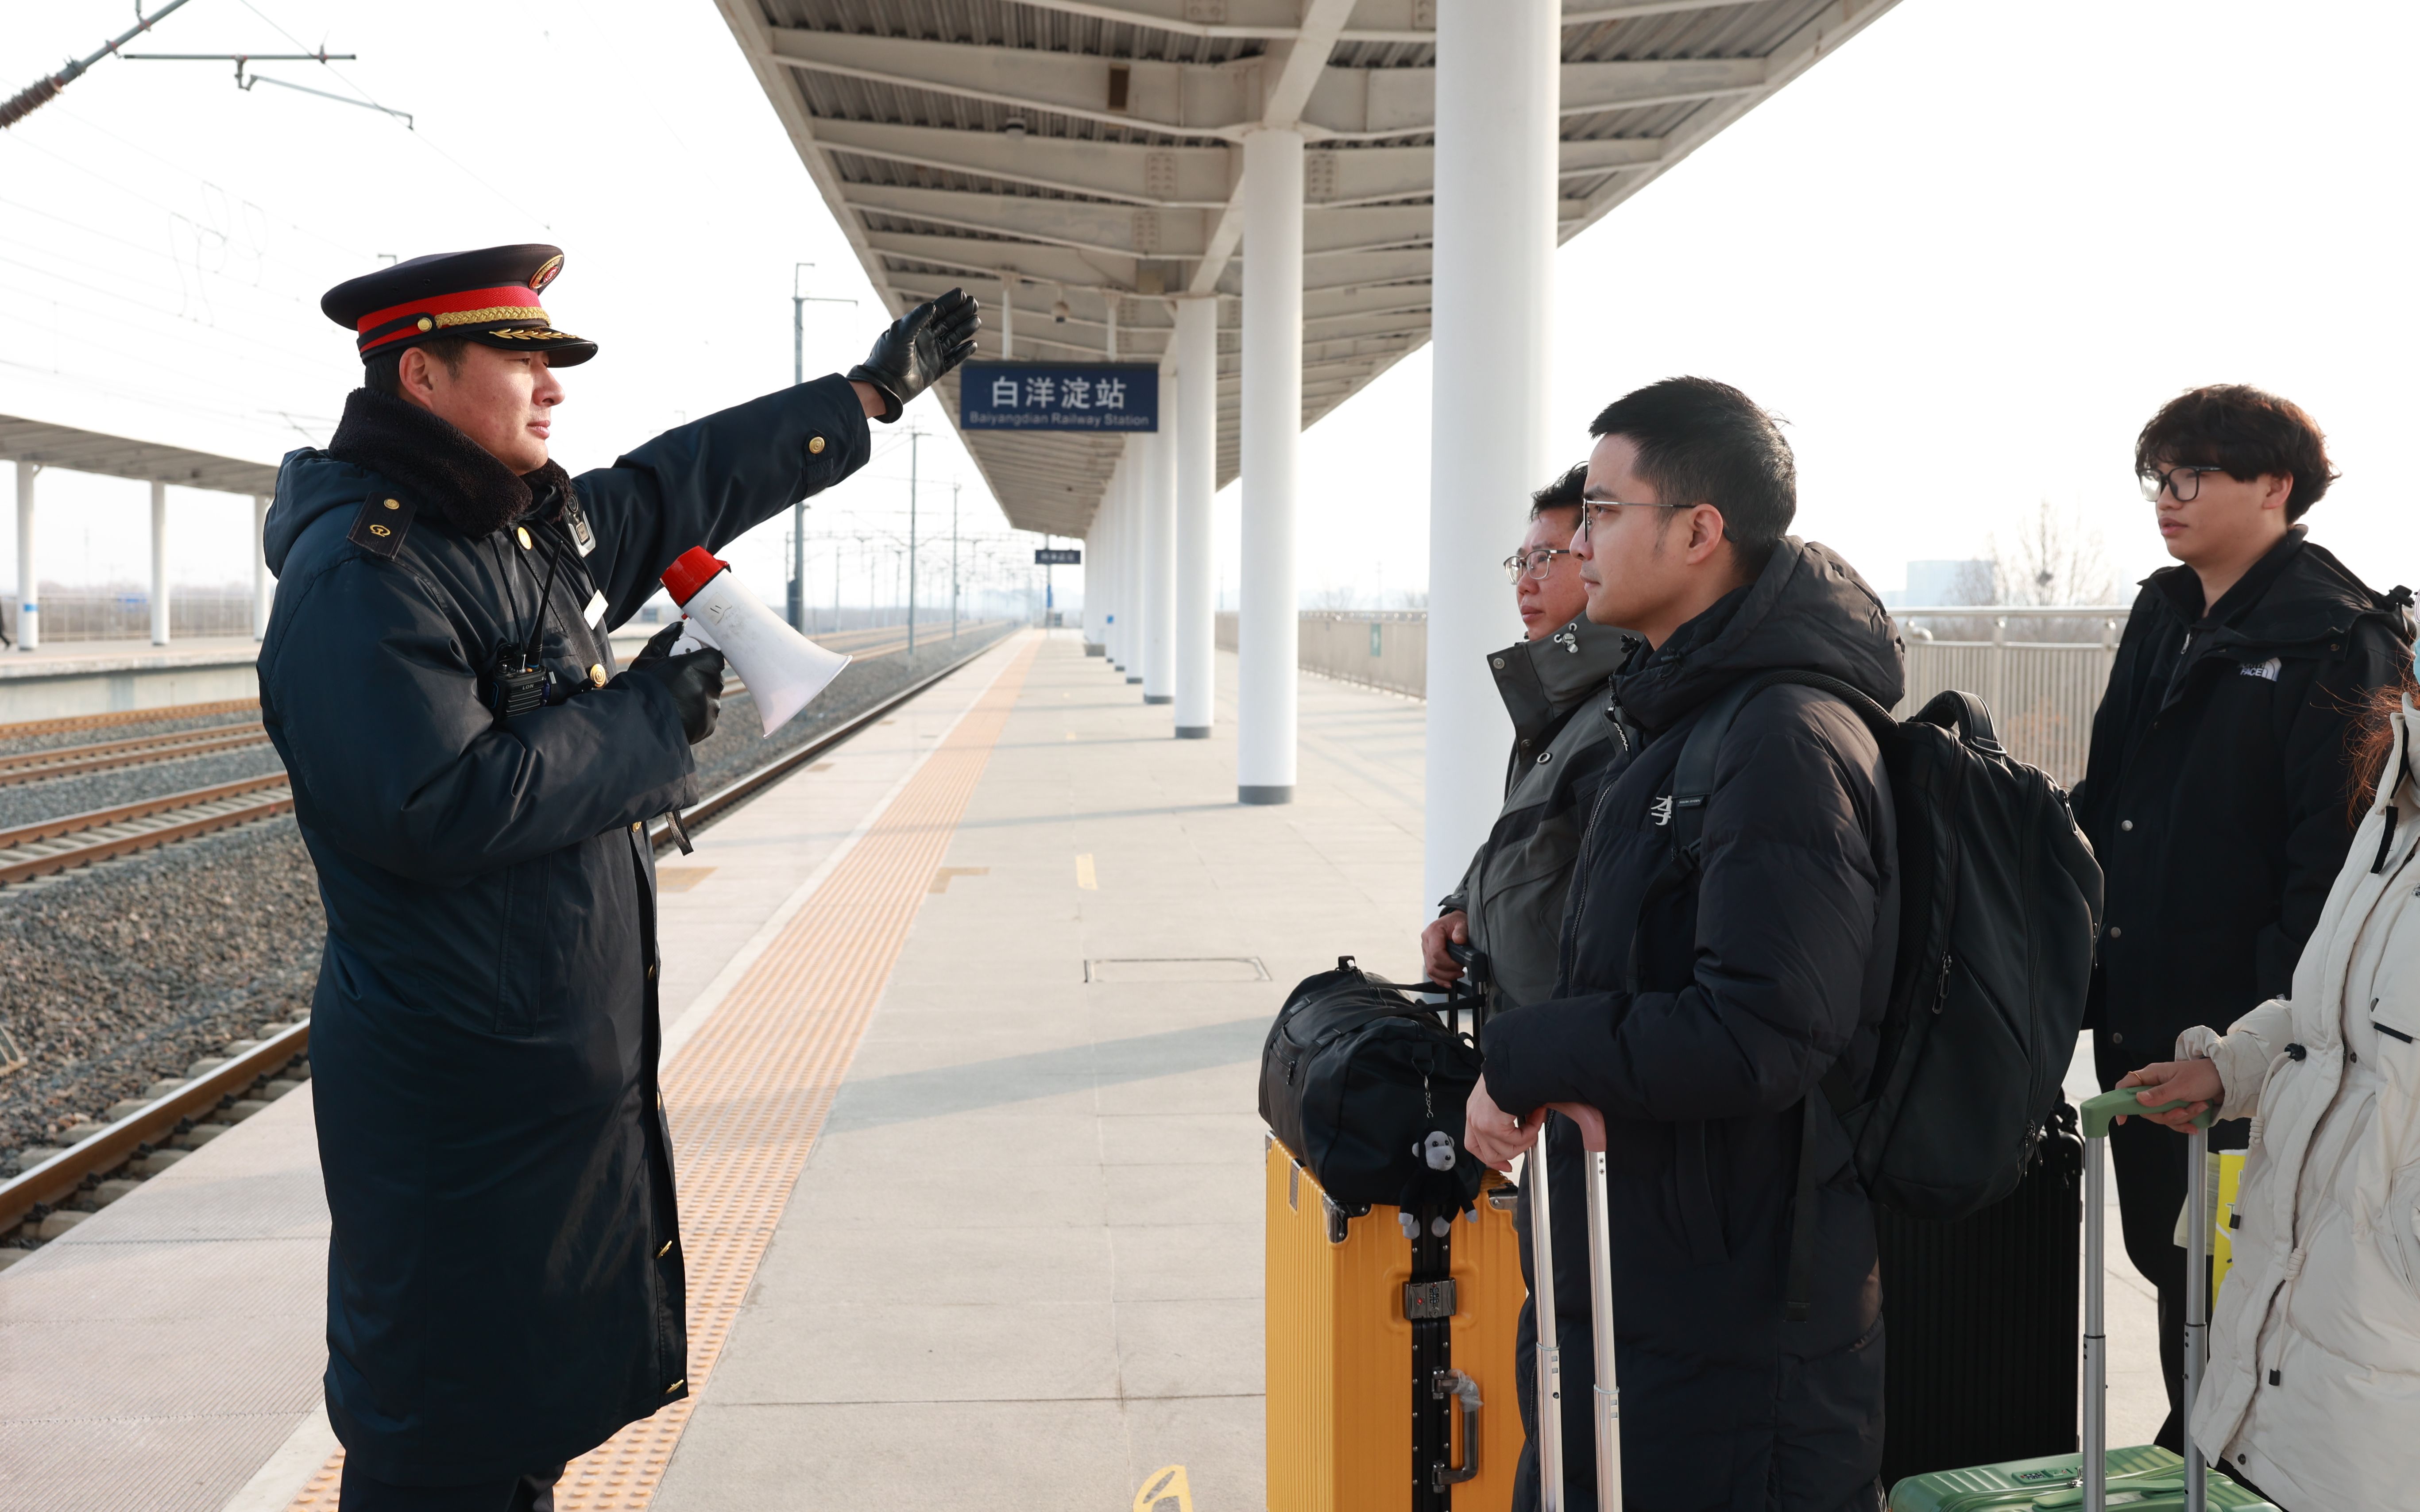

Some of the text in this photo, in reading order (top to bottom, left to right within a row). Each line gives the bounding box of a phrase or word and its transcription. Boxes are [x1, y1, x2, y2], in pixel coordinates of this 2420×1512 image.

[992, 376, 1126, 409] 白洋淀站
[970, 411, 1149, 428] Baiyangdian Railway Station
[2240, 667, 2263, 676] FACE
